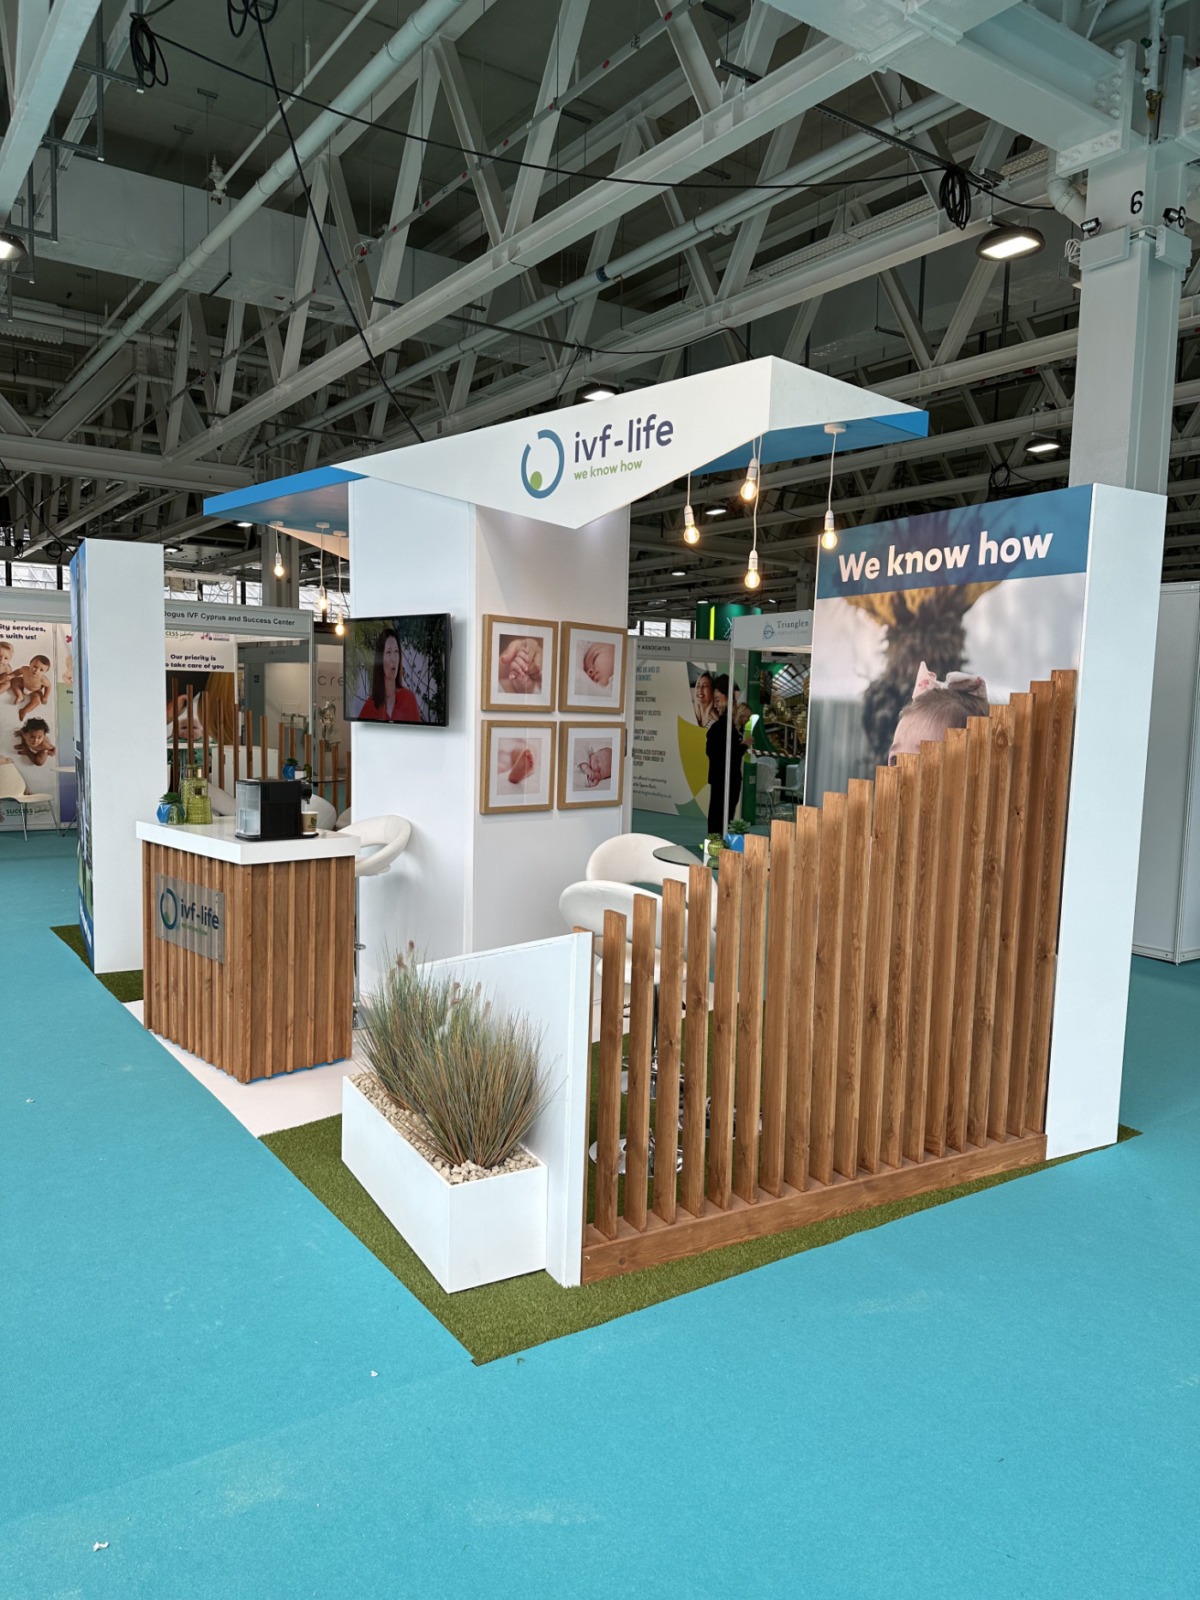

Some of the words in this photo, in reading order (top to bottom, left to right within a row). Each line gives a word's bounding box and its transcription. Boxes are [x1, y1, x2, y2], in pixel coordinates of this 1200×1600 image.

[1130, 190, 1144, 214] 6
[1178, 206, 1186, 229] 6
[574, 413, 674, 463] ivf-life
[574, 470, 587, 480] we
[591, 463, 618, 479] know
[621, 460, 643, 472] how
[838, 551, 880, 583] We
[887, 544, 970, 577] know
[978, 531, 1054, 566] how
[200, 612, 226, 622] Cyprus
[242, 616, 272, 625] Success
[272, 618, 295, 626] Center
[180, 898, 219, 930] ivf-life
